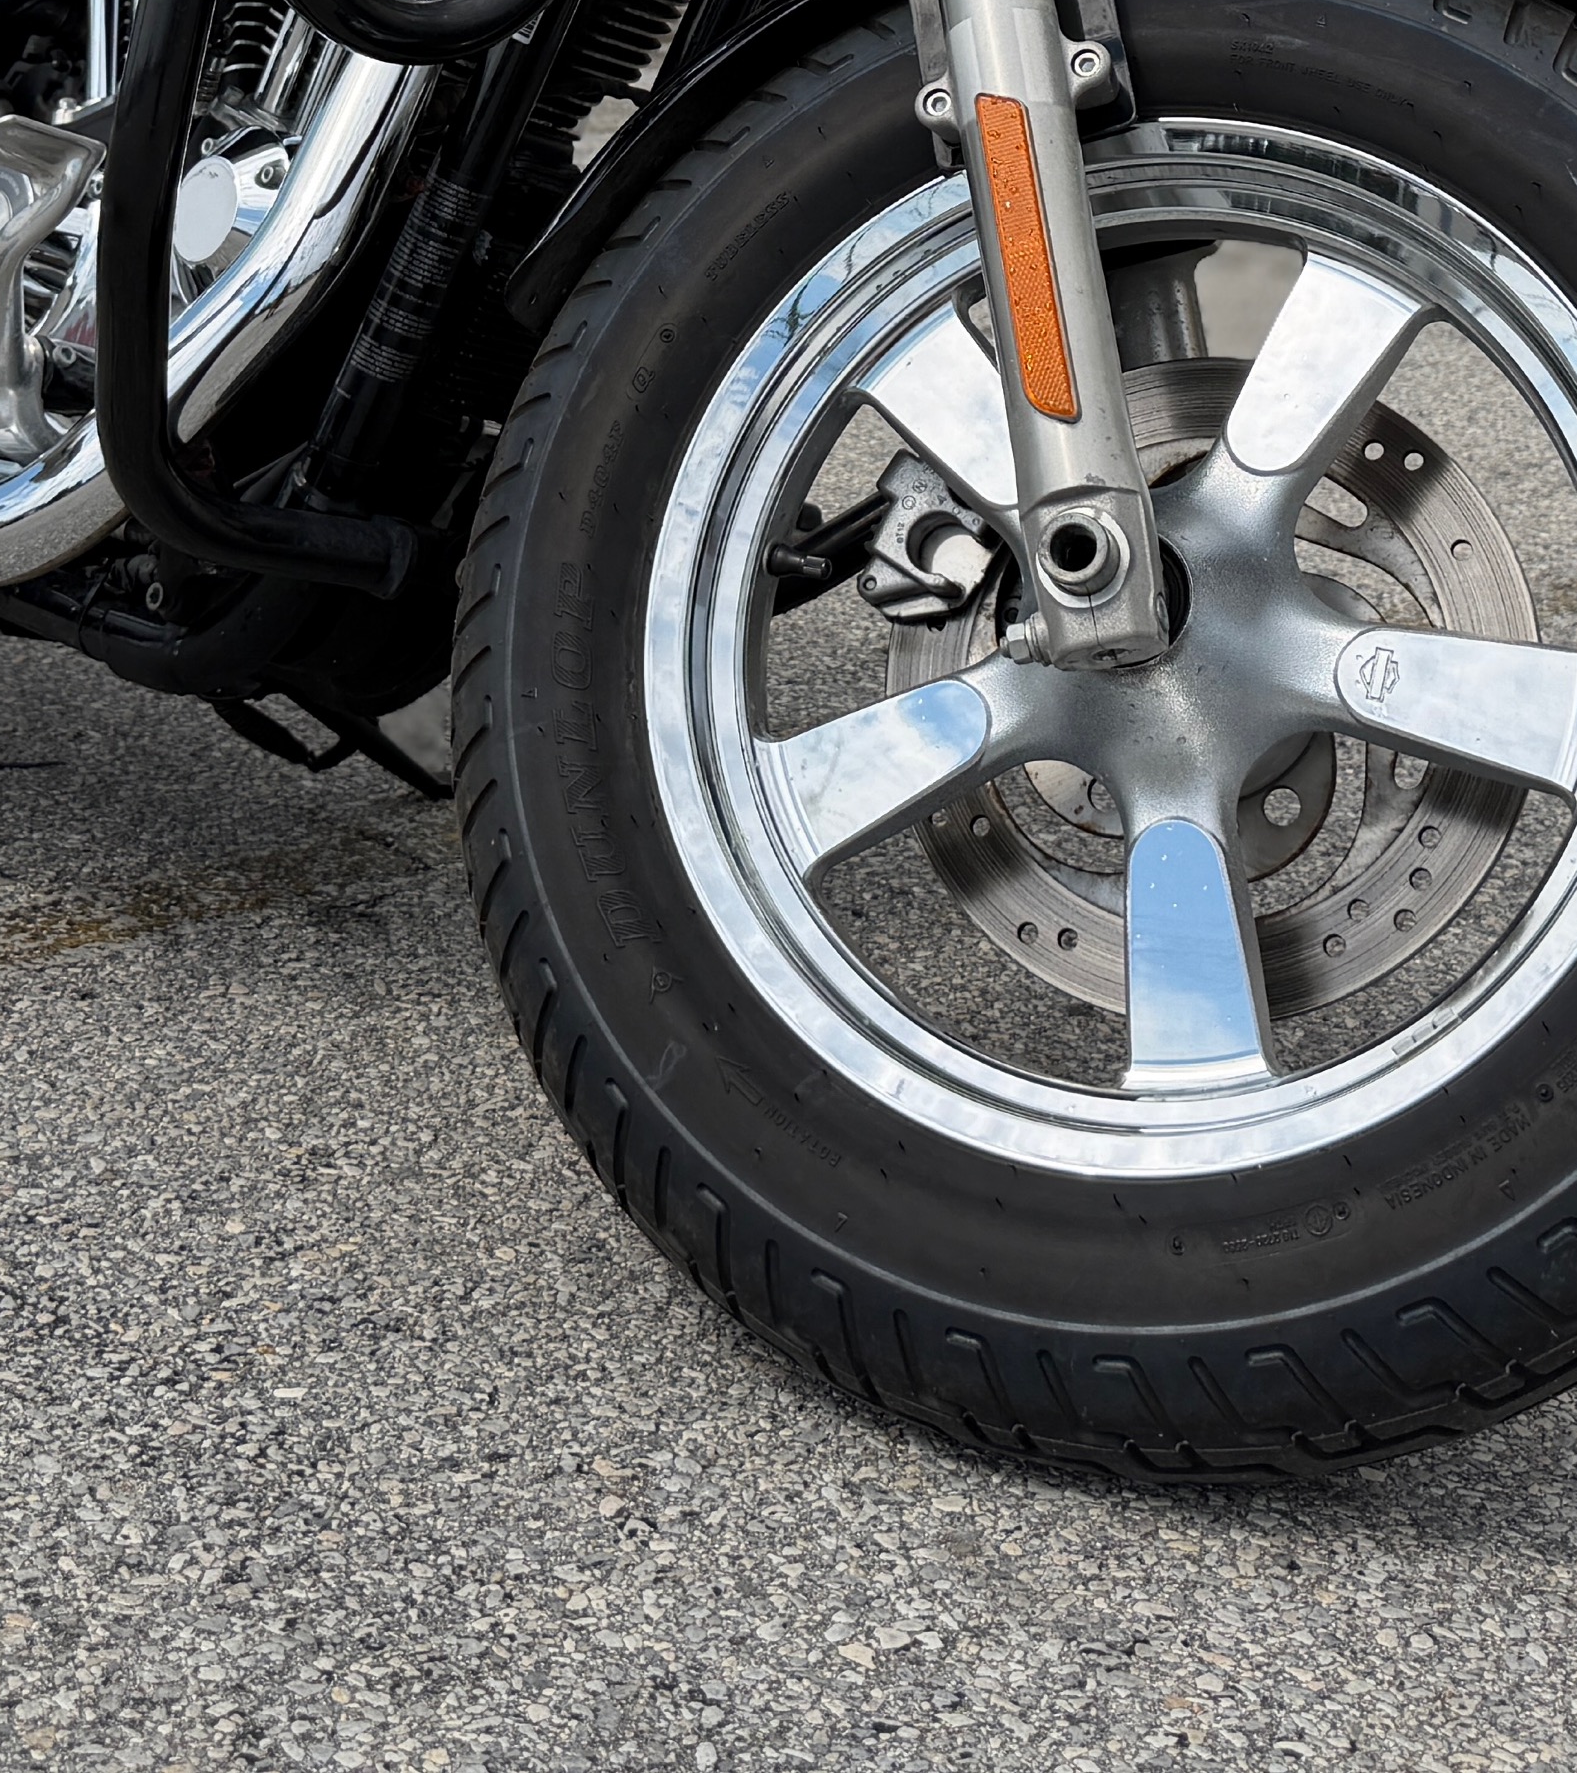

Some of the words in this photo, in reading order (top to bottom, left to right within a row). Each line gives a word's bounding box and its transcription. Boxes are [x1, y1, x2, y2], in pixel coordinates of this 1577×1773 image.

[1259, 58, 1295, 74] FRONT
[551, 561, 662, 948] DUNLOP
[763, 1104, 843, 1169] ROTATION
[1493, 1112, 1532, 1153] MADE
[1469, 1145, 1489, 1167] IN
[1384, 1159, 1470, 1211] INDONESIA
